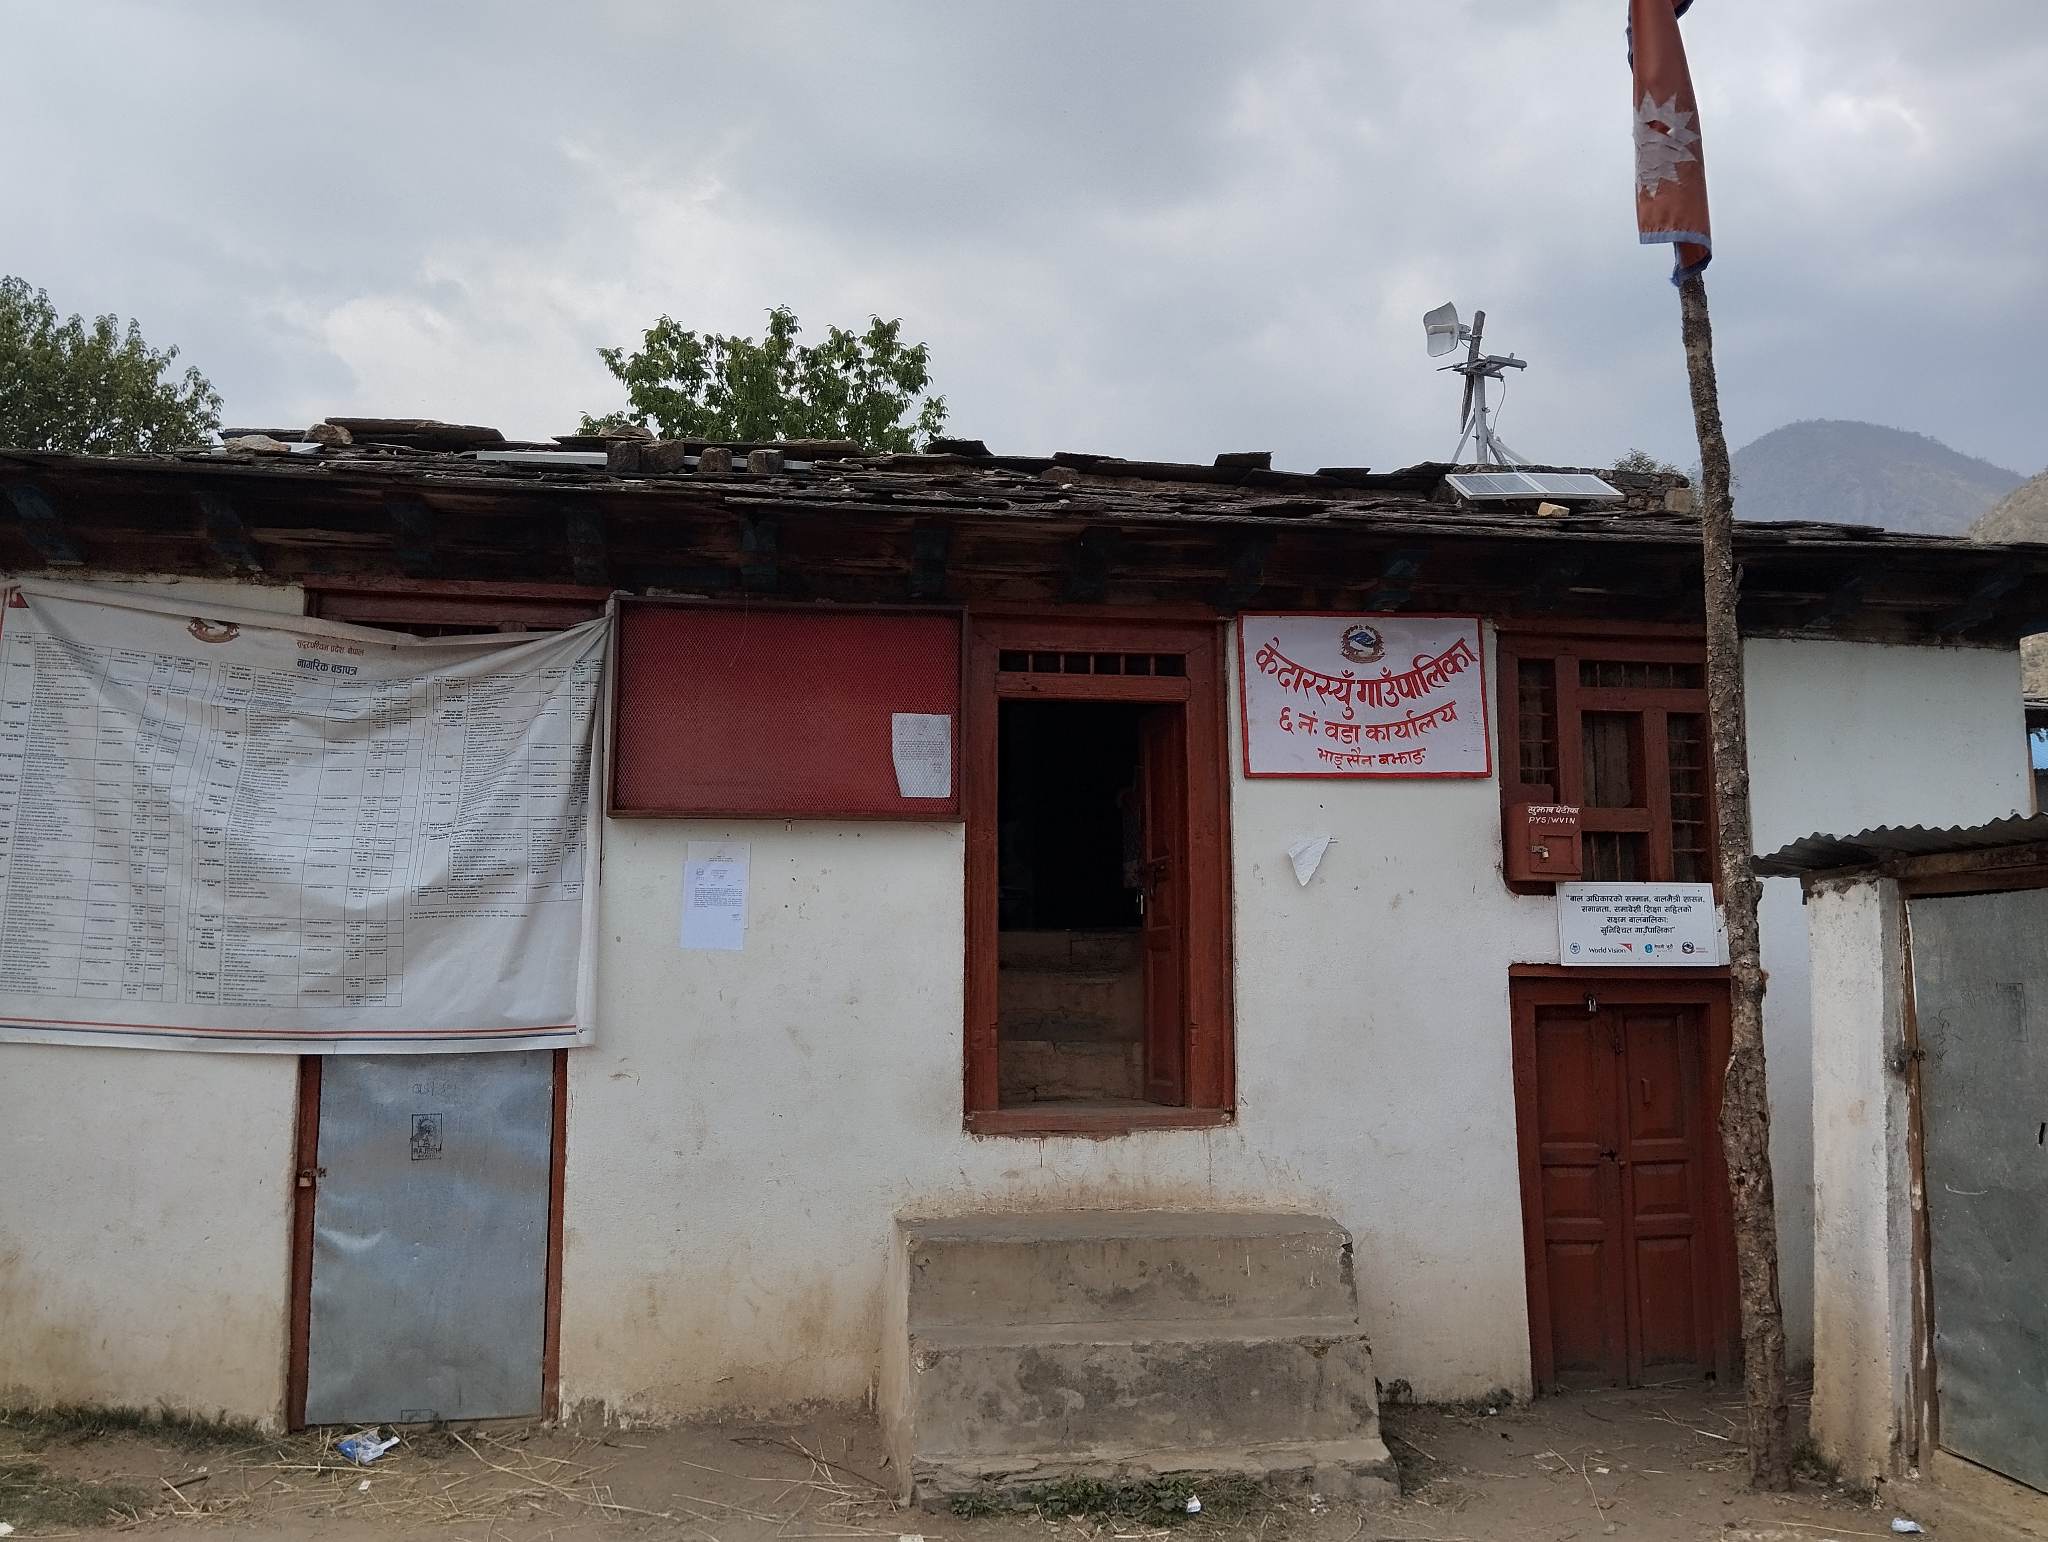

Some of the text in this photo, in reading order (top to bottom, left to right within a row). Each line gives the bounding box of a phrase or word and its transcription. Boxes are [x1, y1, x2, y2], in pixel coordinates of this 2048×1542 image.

[297, 658, 358, 675] नागरिक वडापत्र
[1356, 637, 1478, 708] गाउँपालिका
[1325, 720, 1361, 744] वडा
[1366, 701, 1458, 742] कार्यालय
[1585, 893, 1623, 902] अधिकारको
